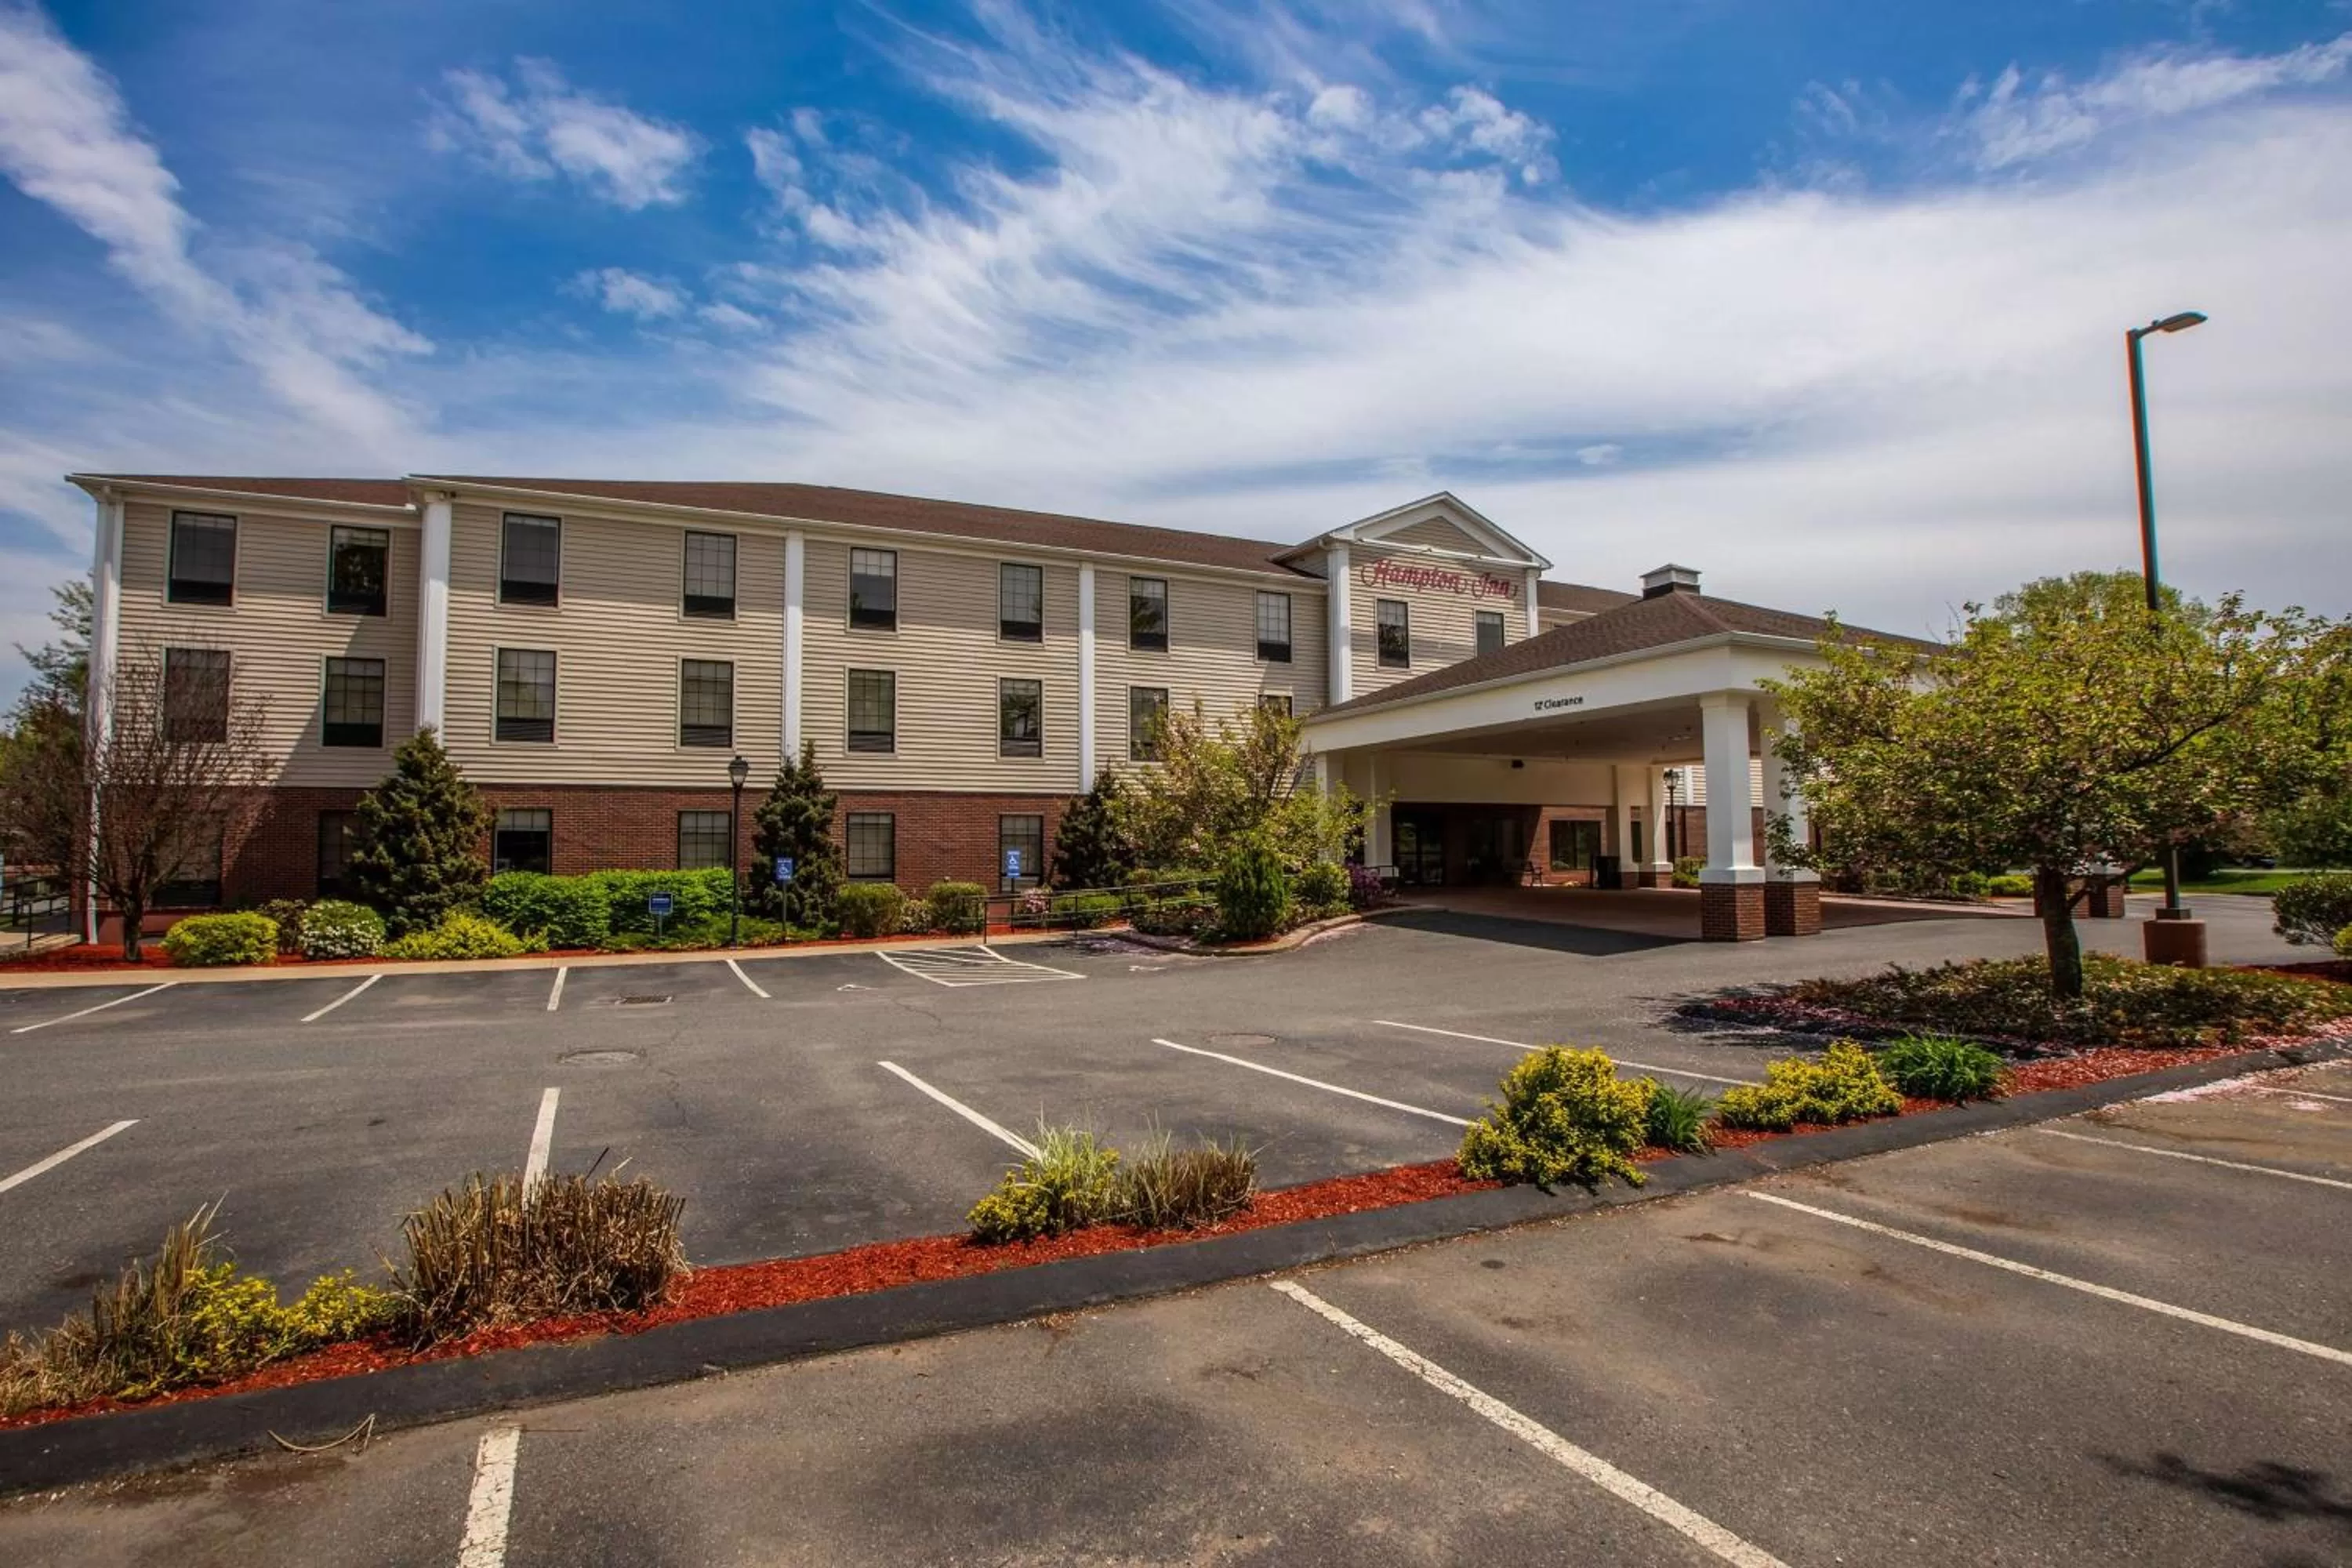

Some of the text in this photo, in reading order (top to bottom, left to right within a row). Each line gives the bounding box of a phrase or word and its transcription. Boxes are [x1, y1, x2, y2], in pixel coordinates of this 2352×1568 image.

[1361, 557, 1519, 600] Hampton Inn
[1544, 696, 1584, 710] Clearance
